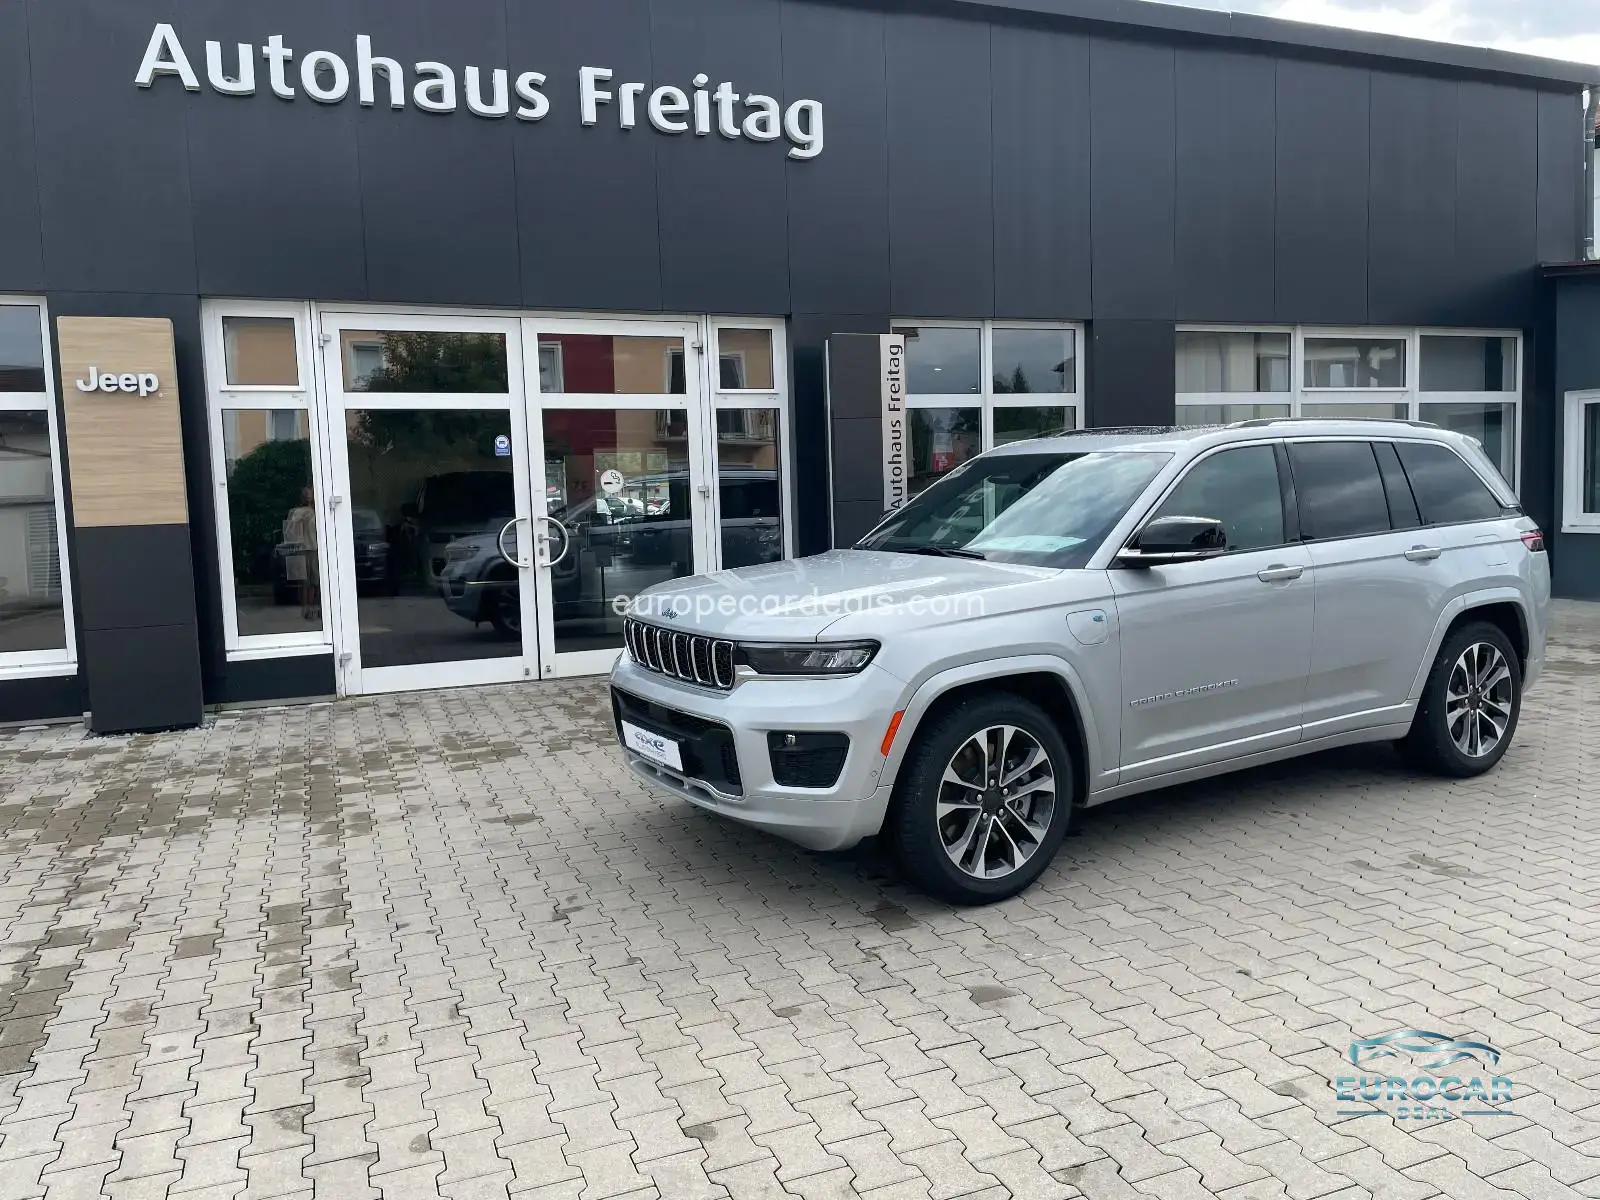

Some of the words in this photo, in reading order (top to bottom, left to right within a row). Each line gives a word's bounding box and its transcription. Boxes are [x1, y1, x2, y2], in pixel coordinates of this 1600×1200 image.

[135, 23, 551, 122] Autohaus
[578, 66, 825, 160] Freitag
[76, 366, 160, 397] Jeep
[886, 344, 903, 412] Freitag
[887, 419, 905, 510] Autohaus
